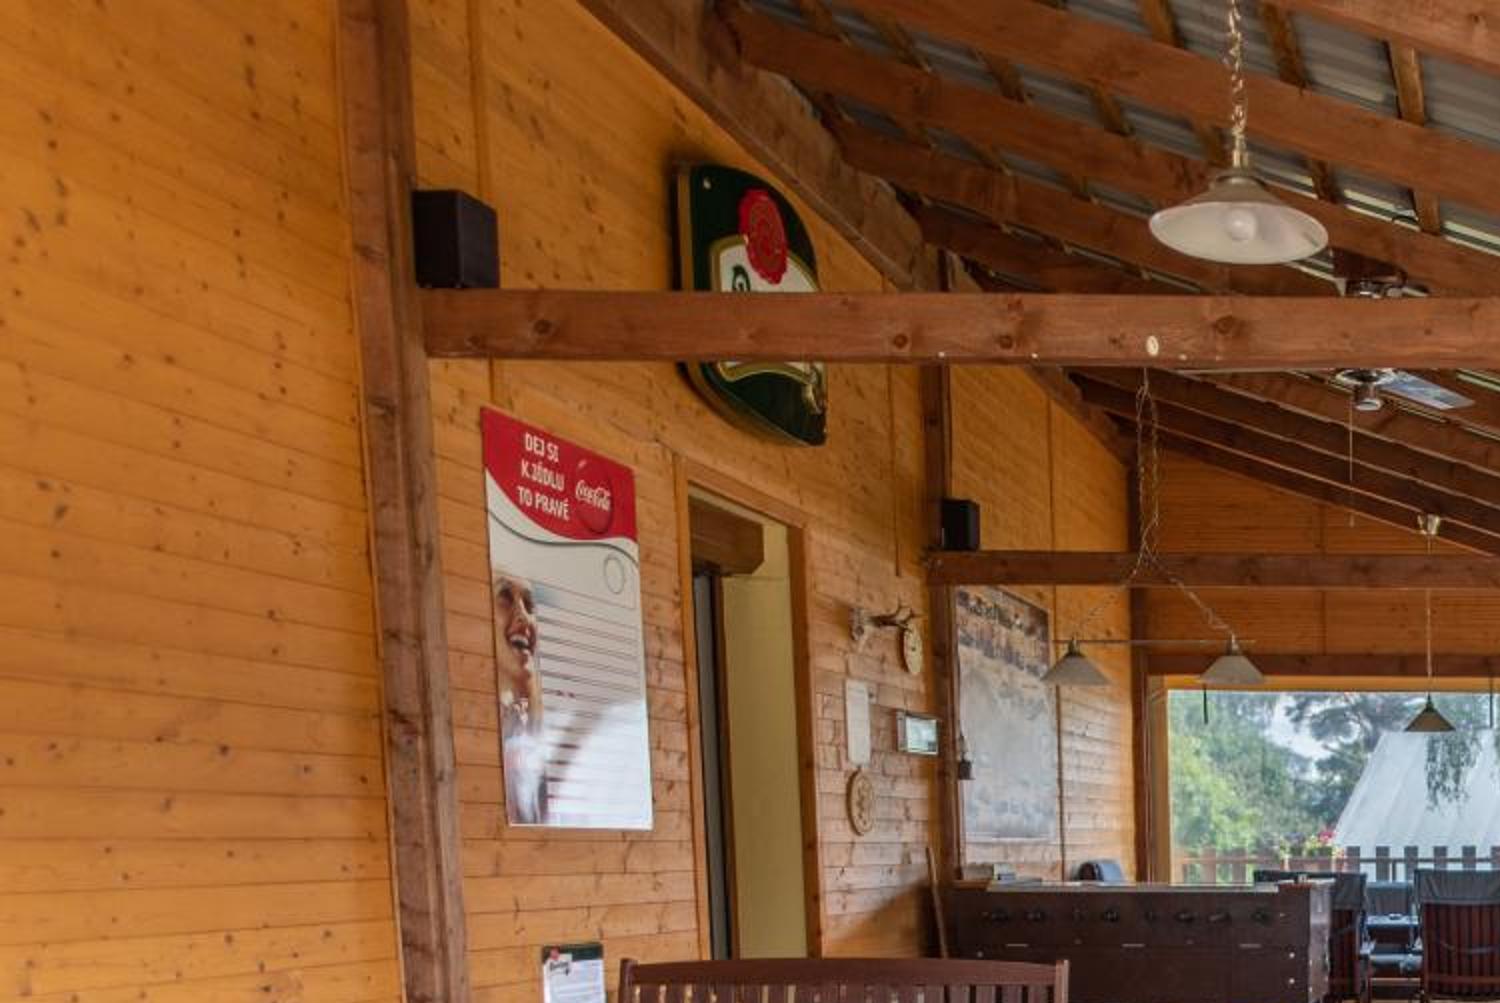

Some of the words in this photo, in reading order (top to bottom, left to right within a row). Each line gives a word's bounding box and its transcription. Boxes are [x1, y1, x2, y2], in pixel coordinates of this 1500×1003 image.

[525, 432, 544, 456] DEJ
[517, 486, 532, 507] TO
[536, 492, 570, 521] PRAVÉ
[575, 480, 611, 511] Coca-Cola
